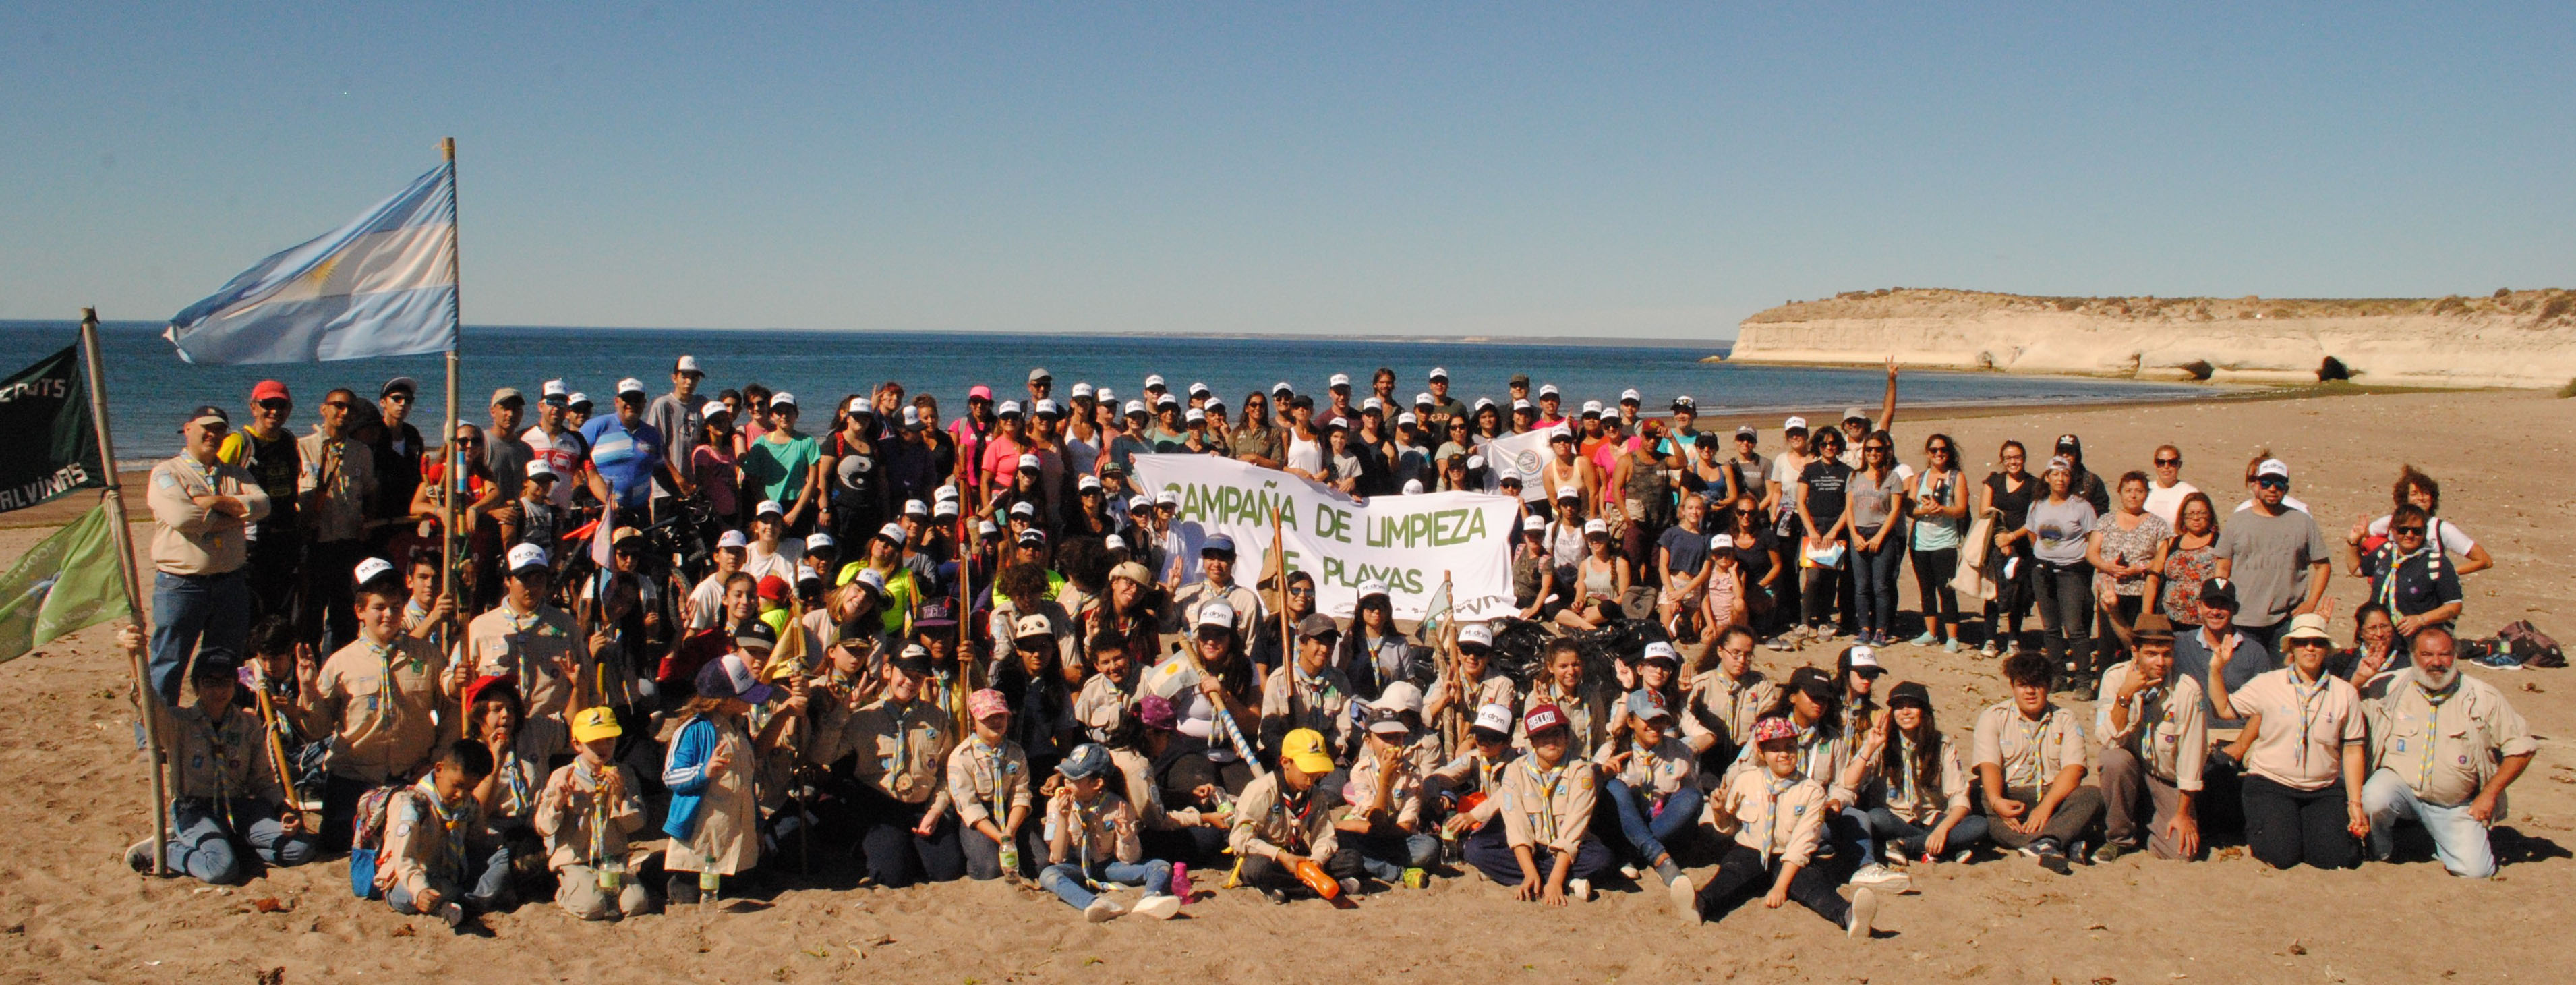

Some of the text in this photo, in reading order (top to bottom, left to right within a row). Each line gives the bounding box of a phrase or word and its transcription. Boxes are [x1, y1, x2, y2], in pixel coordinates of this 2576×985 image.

[1315, 503, 1351, 544] DE
[1366, 507, 1486, 548] LIMPIEZA
[1323, 555, 1424, 594] PLAYAS
